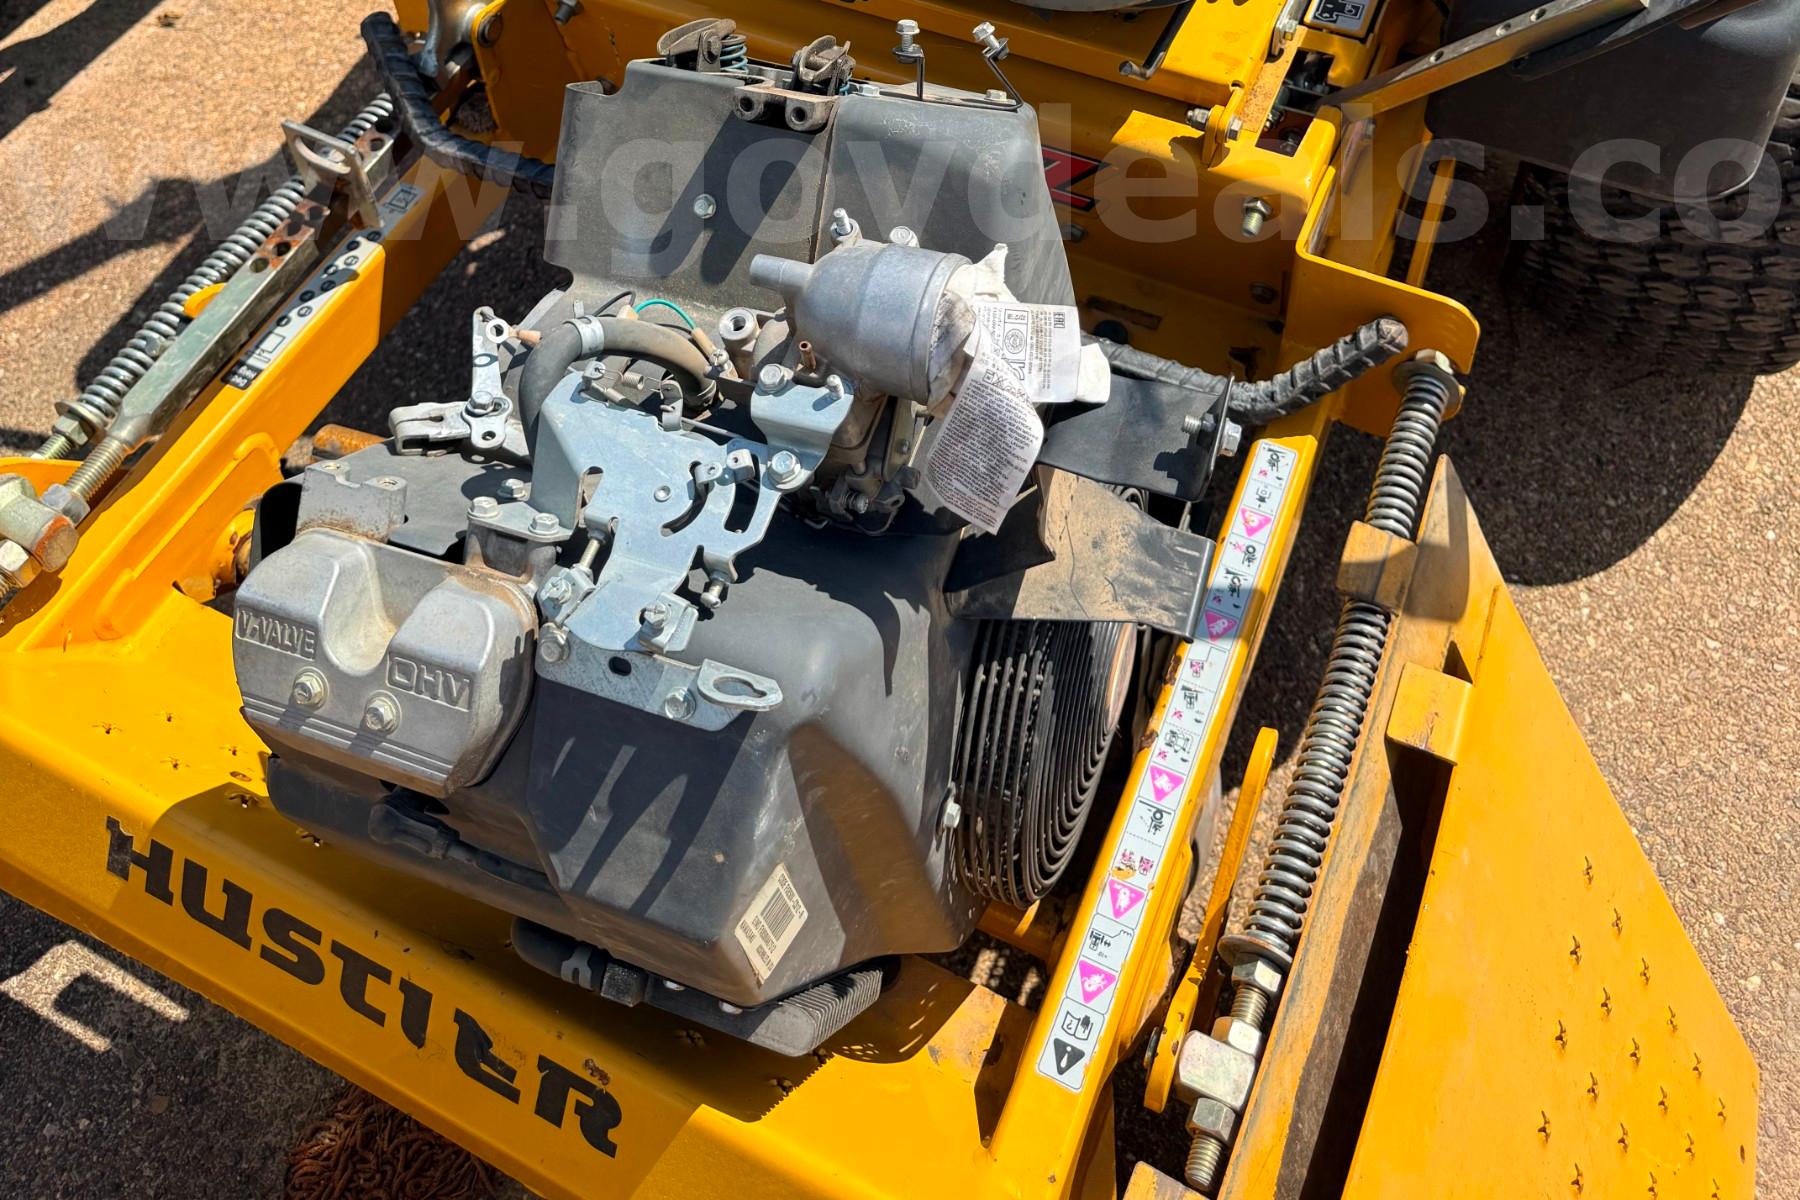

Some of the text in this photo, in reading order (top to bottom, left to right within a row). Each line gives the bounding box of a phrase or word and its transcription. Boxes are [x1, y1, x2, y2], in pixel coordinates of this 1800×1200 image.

[237, 610, 318, 660] V-VALVE
[389, 655, 471, 710] OHV
[106, 815, 624, 1158] HUSTLER
